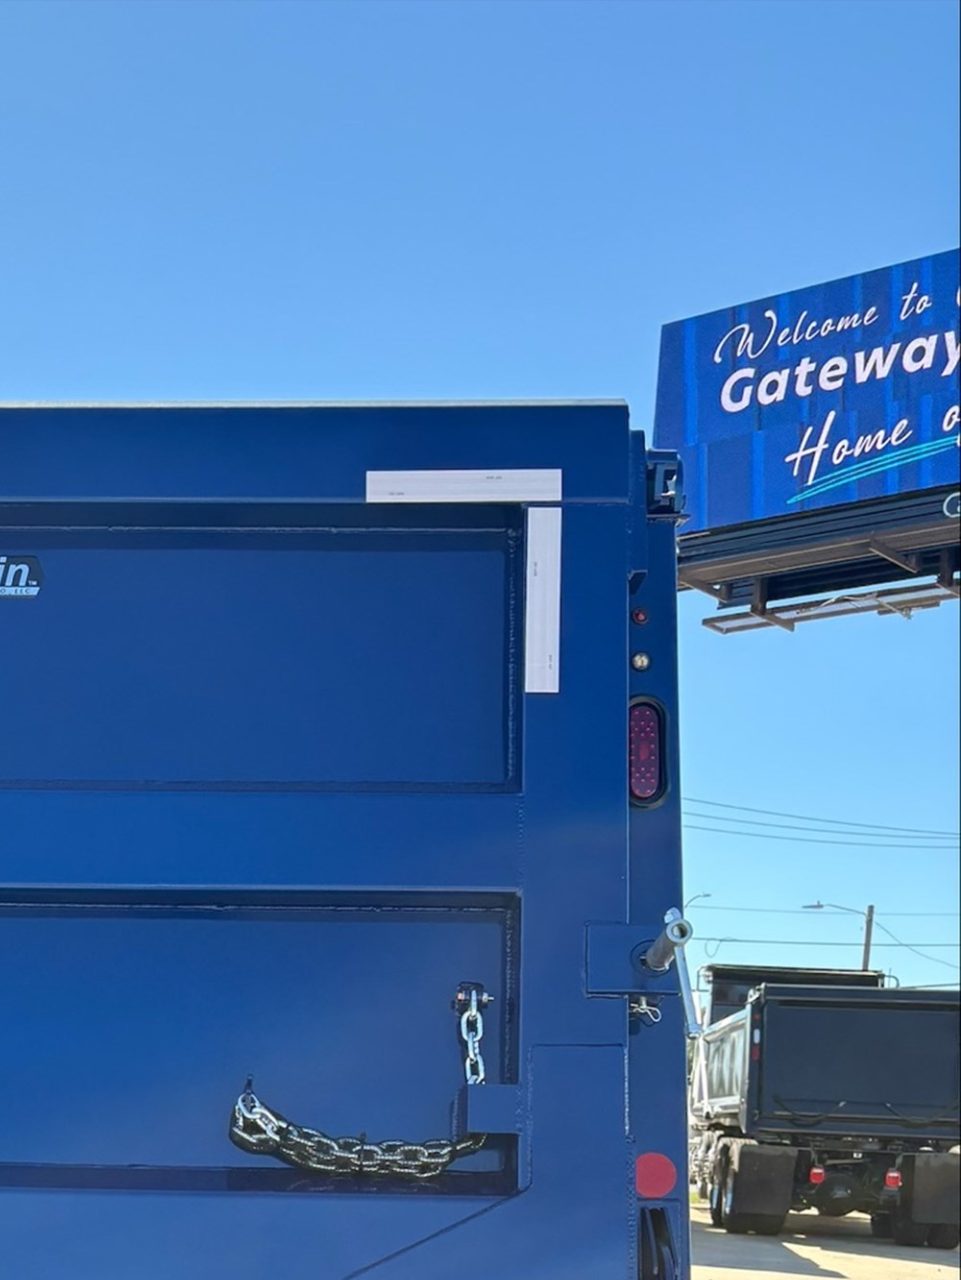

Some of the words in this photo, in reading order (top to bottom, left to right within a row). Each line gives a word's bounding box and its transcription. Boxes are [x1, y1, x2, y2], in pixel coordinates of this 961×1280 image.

[713, 306, 879, 364] Welcome
[899, 281, 932, 321] to
[785, 410, 913, 486] Home
